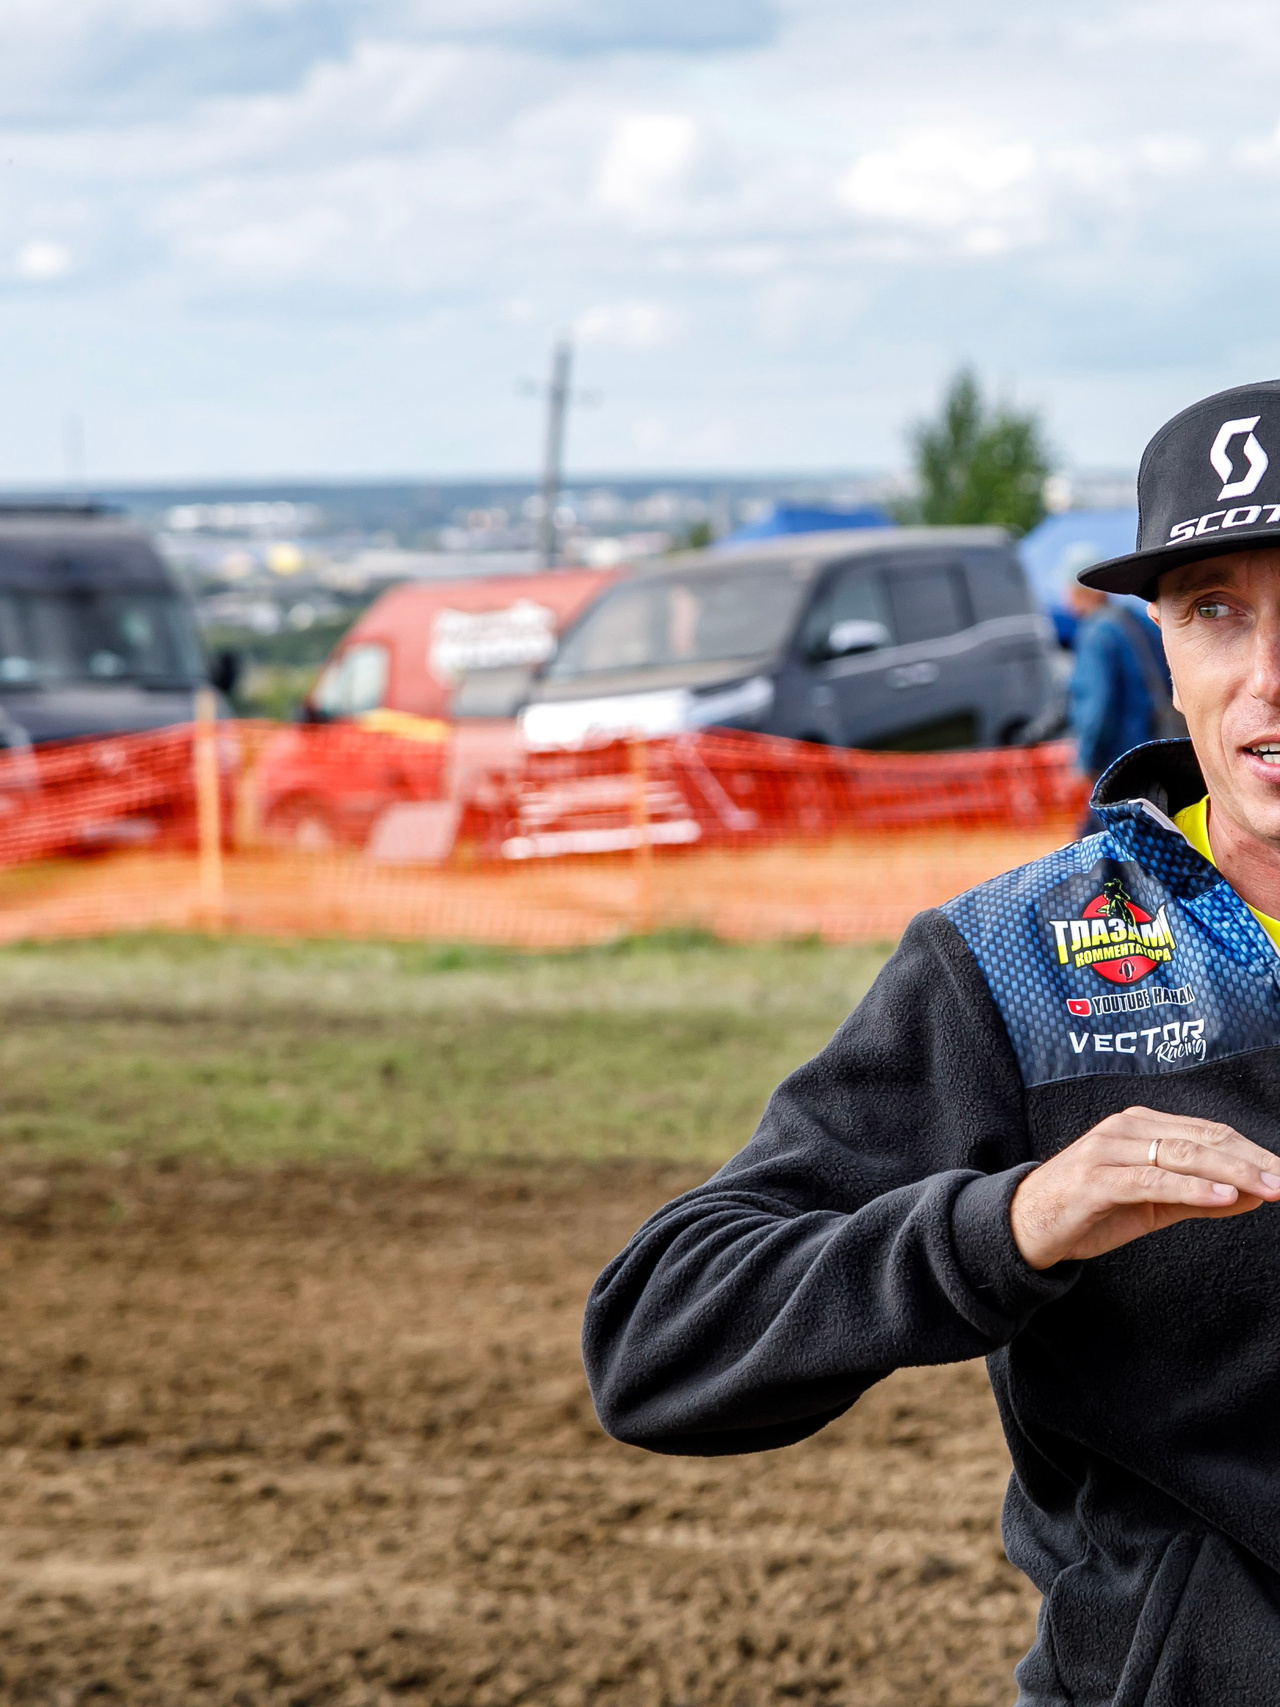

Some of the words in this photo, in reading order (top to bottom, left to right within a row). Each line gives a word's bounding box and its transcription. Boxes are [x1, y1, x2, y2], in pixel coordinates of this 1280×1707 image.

[1075, 942, 1172, 968] КОММЕНТАТОРА
[1092, 989, 1150, 1015] YOUTUBE
[1069, 1018, 1205, 1055] VECTOR
[1155, 1037, 1207, 1063] Racing
